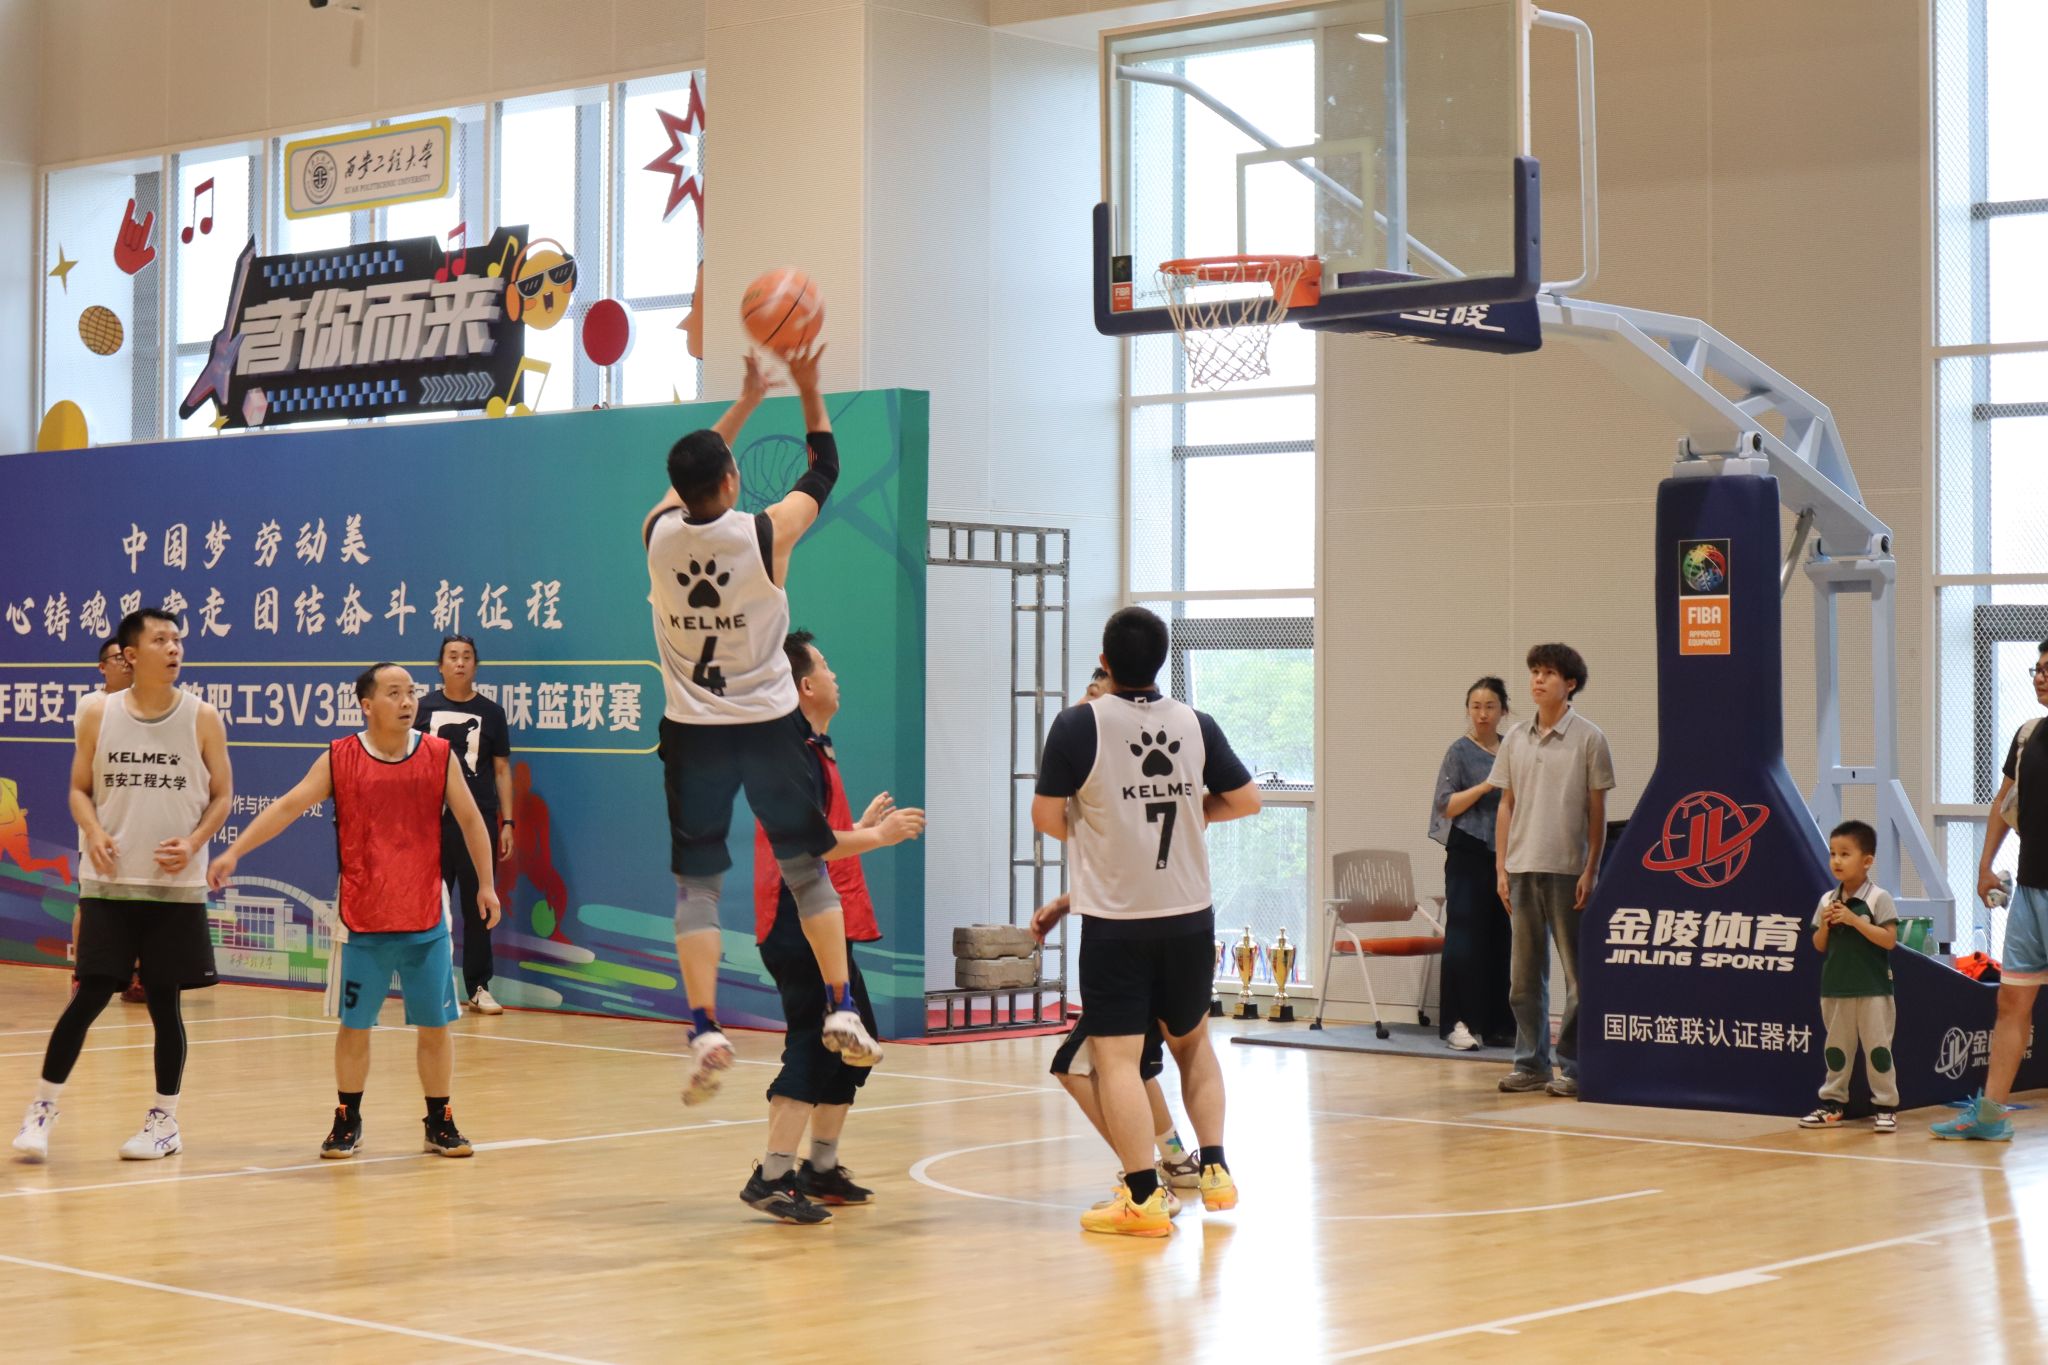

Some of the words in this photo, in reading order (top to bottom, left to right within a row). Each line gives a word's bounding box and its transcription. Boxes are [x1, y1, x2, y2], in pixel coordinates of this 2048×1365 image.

[122, 519, 232, 573] 中国梦
[254, 513, 372, 567] 劳动美
[254, 580, 564, 636] 团结奋斗新征程
[670, 613, 747, 631] KELME
[1688, 606, 1722, 625] FIBA
[692, 636, 727, 696] 4
[108, 752, 167, 765] KELME
[104, 773, 187, 791] 西安工程大学
[1122, 783, 1192, 800] KELME
[1145, 801, 1177, 870] 7
[1605, 907, 1802, 952] 金陵体育
[1605, 949, 1692, 967] JINLING
[1700, 952, 1795, 972] SPORTS
[344, 980, 361, 1009] 5
[1604, 1013, 1813, 1054] 国际篮联认证器材
